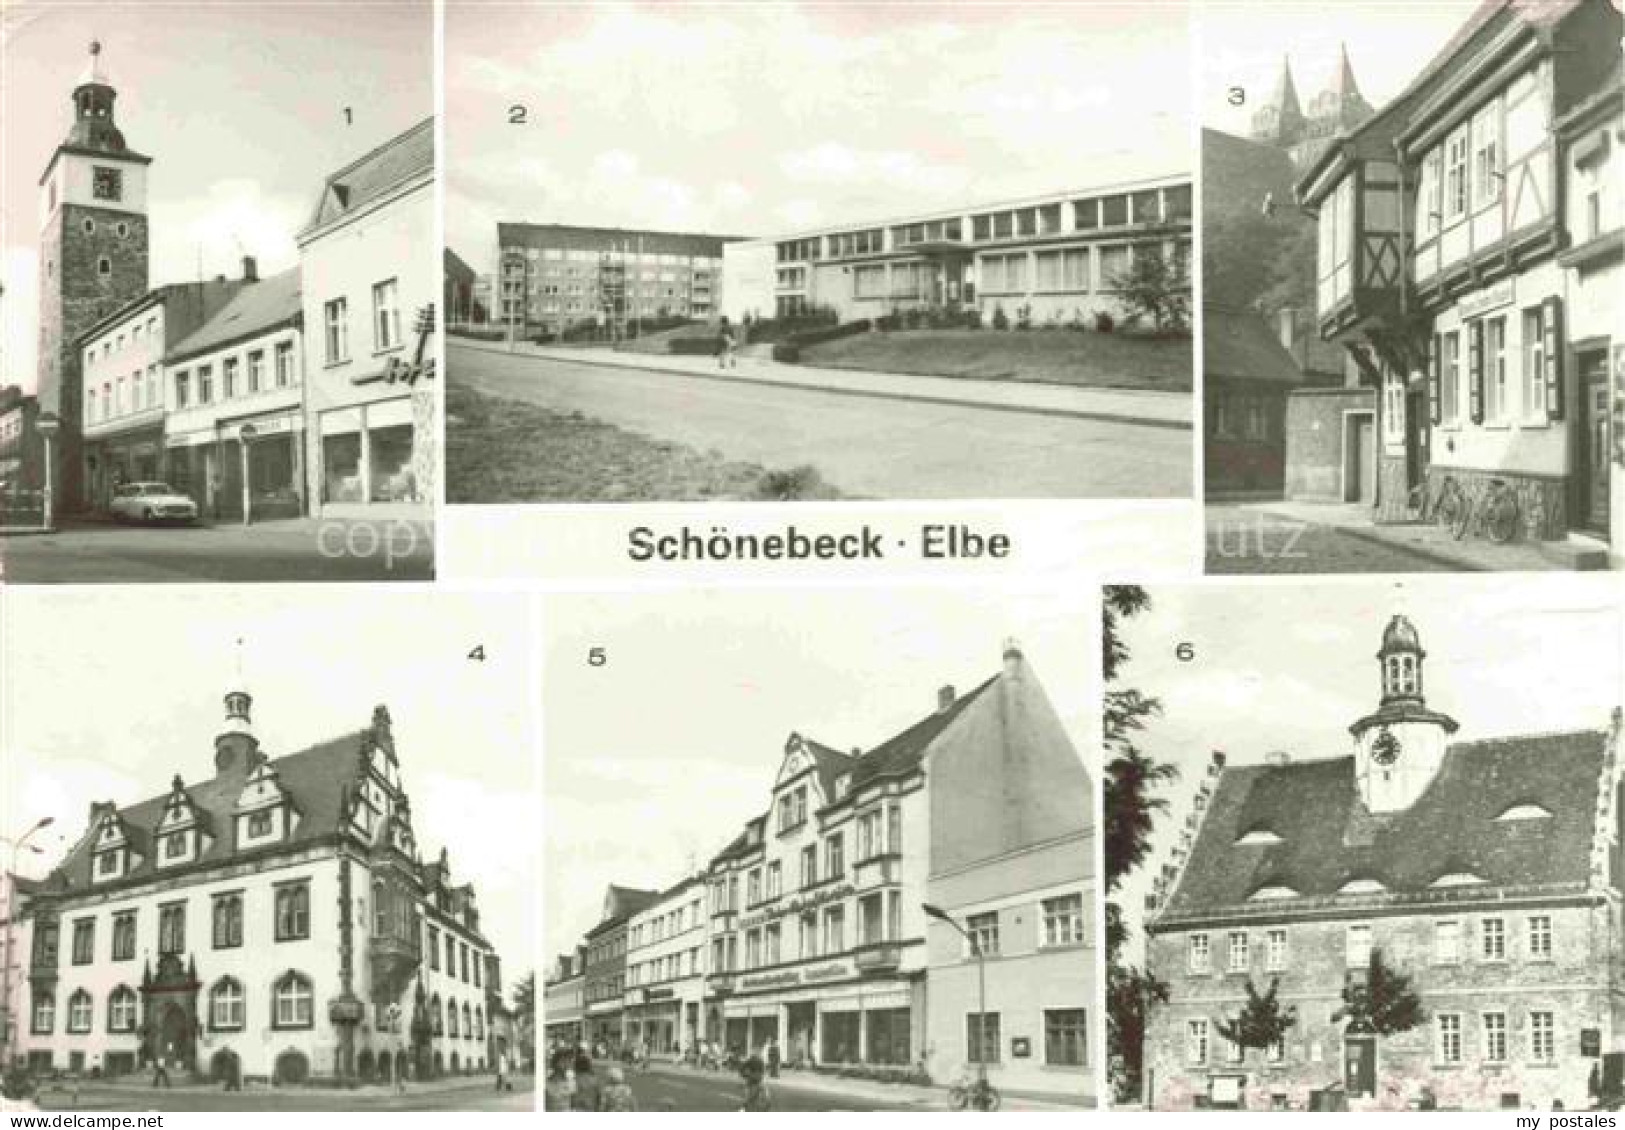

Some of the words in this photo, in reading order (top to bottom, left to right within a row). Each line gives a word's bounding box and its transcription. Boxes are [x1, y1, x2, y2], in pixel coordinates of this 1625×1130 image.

[1228, 87, 1245, 105] 3
[344, 107, 353, 124] 1
[508, 105, 527, 123] 2
[628, 525, 883, 560] Schönebeck
[922, 525, 1010, 560] Elbe
[467, 644, 485, 662] 4
[588, 647, 606, 666] 5
[1176, 642, 1194, 662] 6
